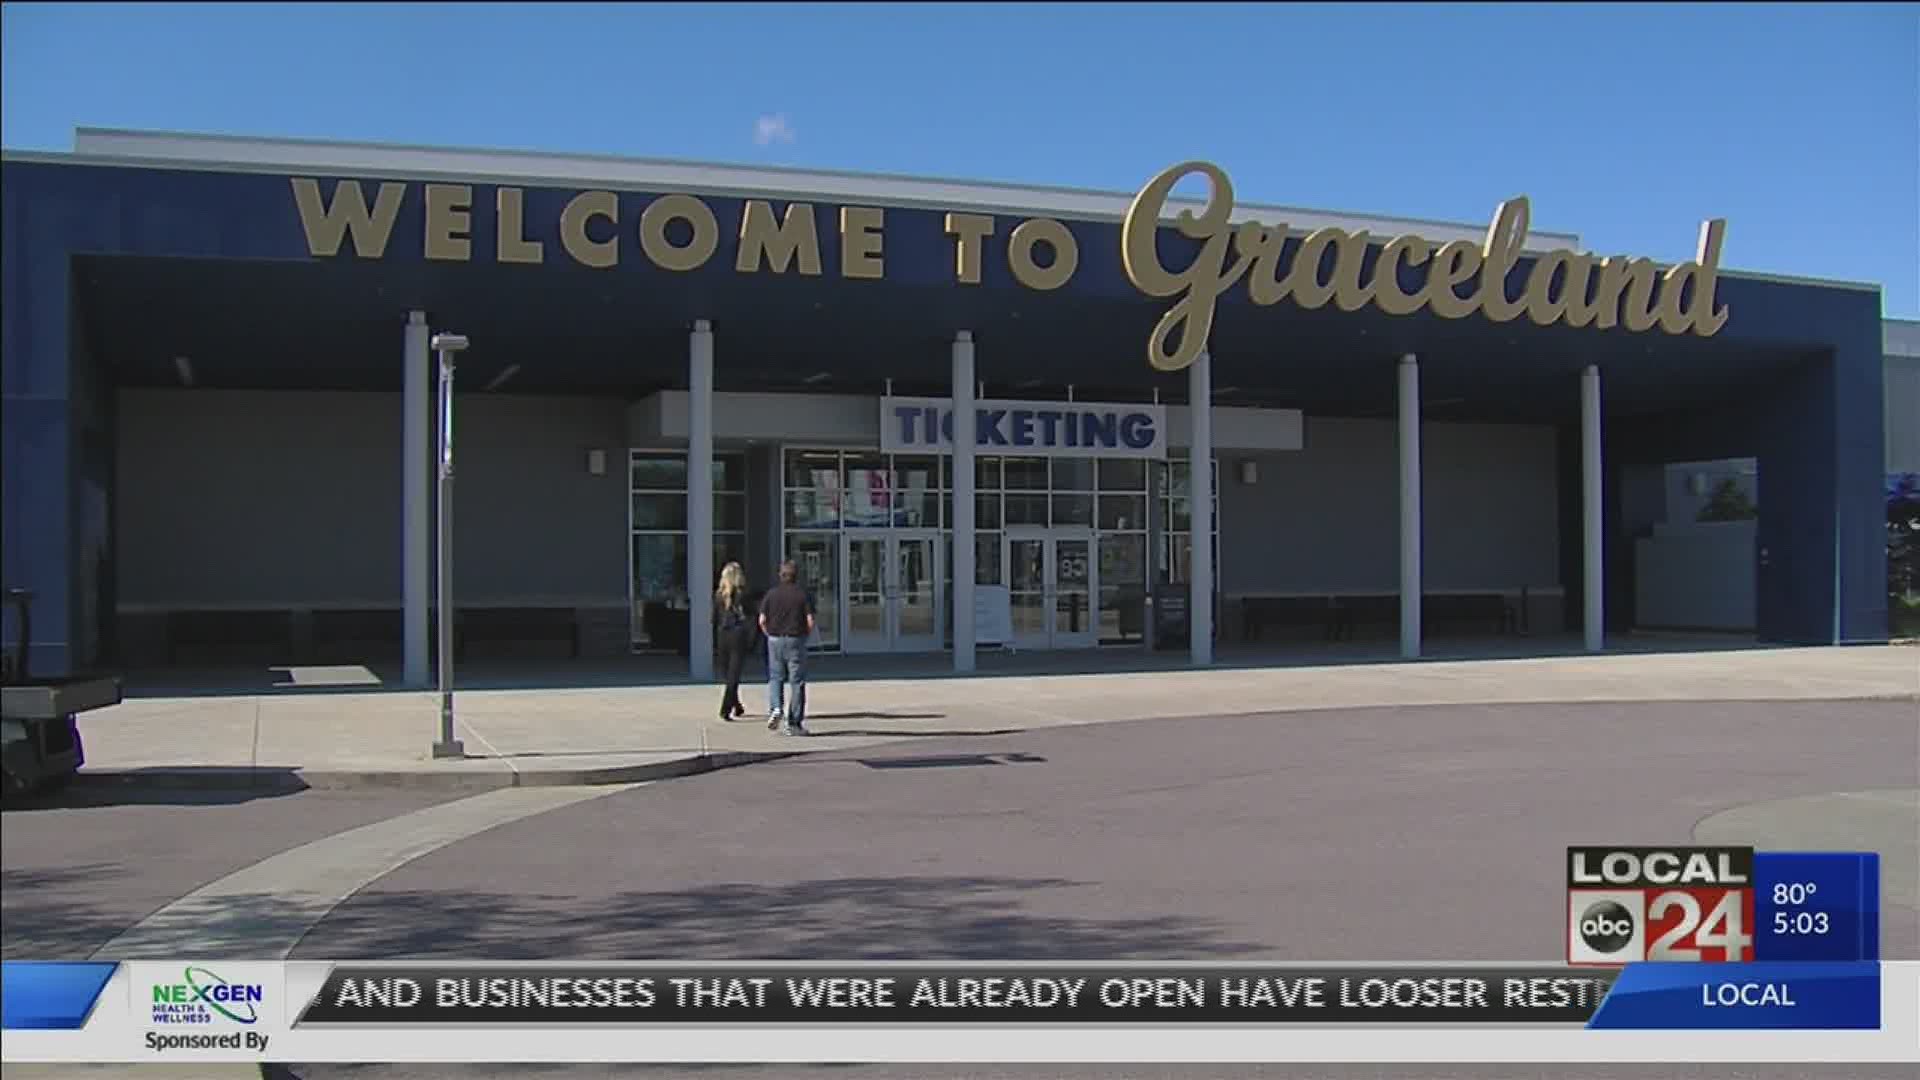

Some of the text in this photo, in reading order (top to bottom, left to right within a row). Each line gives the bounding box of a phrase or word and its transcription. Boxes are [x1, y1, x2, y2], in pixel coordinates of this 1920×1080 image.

[291, 160, 1729, 371] WELCOME TO Graceland
[895, 406, 1155, 449] TIKETING
